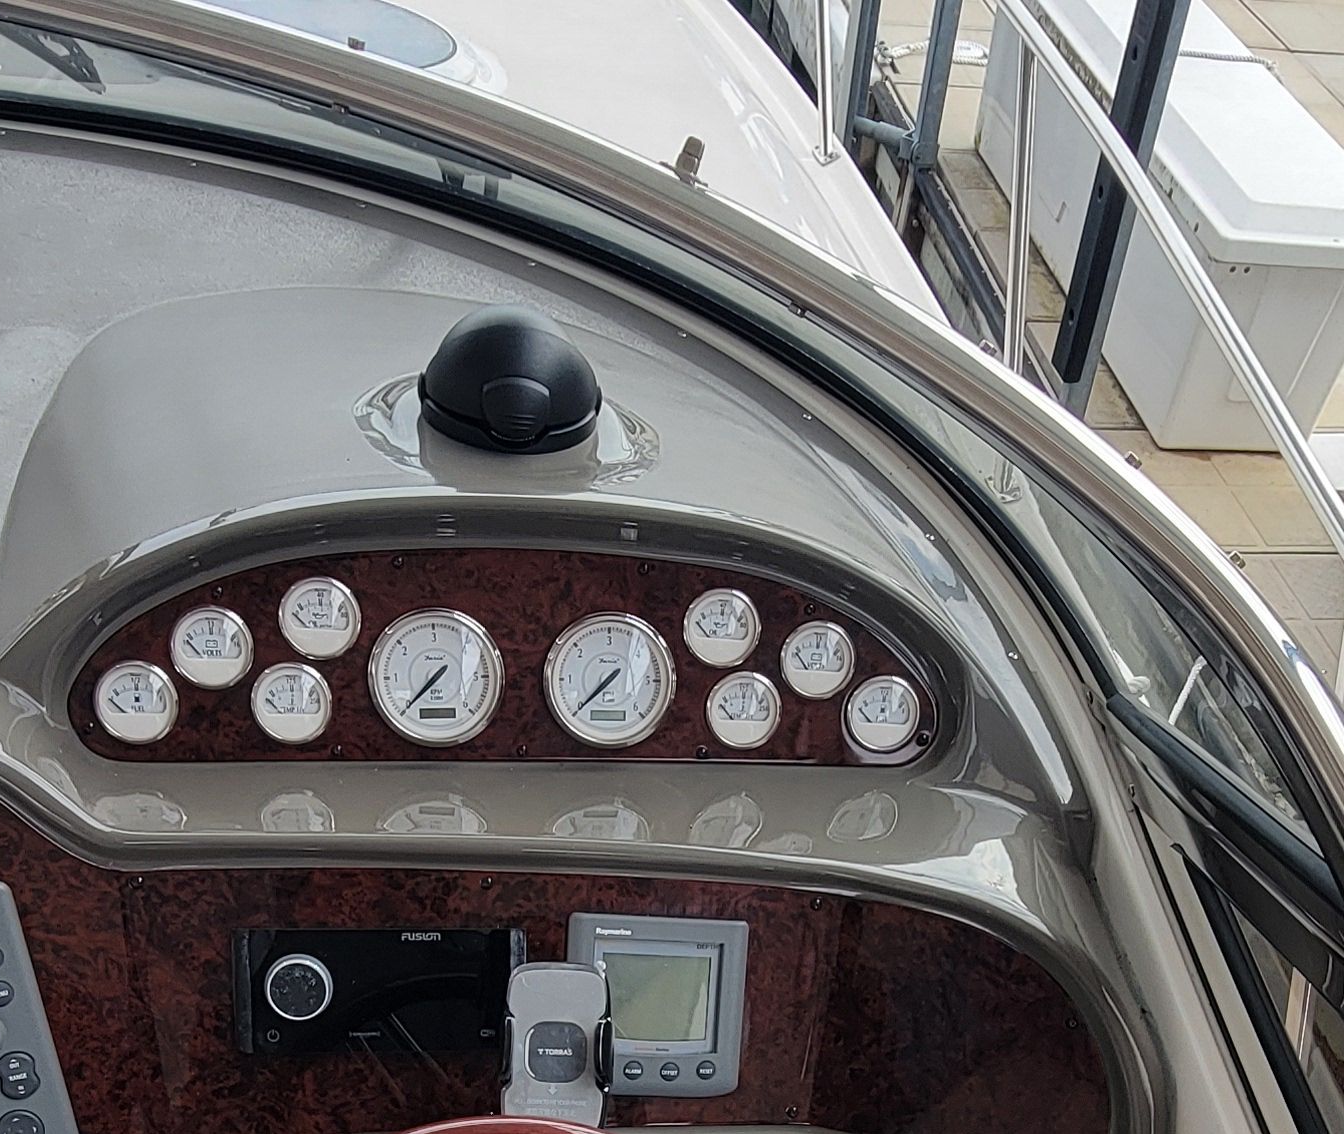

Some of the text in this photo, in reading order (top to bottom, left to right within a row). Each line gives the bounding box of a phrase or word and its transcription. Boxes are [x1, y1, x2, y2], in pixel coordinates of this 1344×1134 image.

[431, 632, 437, 642] 3
[606, 636, 612, 646] 3
[577, 648, 583, 658] 2
[595, 927, 633, 936] Raymarine
[401, 932, 441, 942] FUSION
[8, 1072, 28, 1082] RANGE
